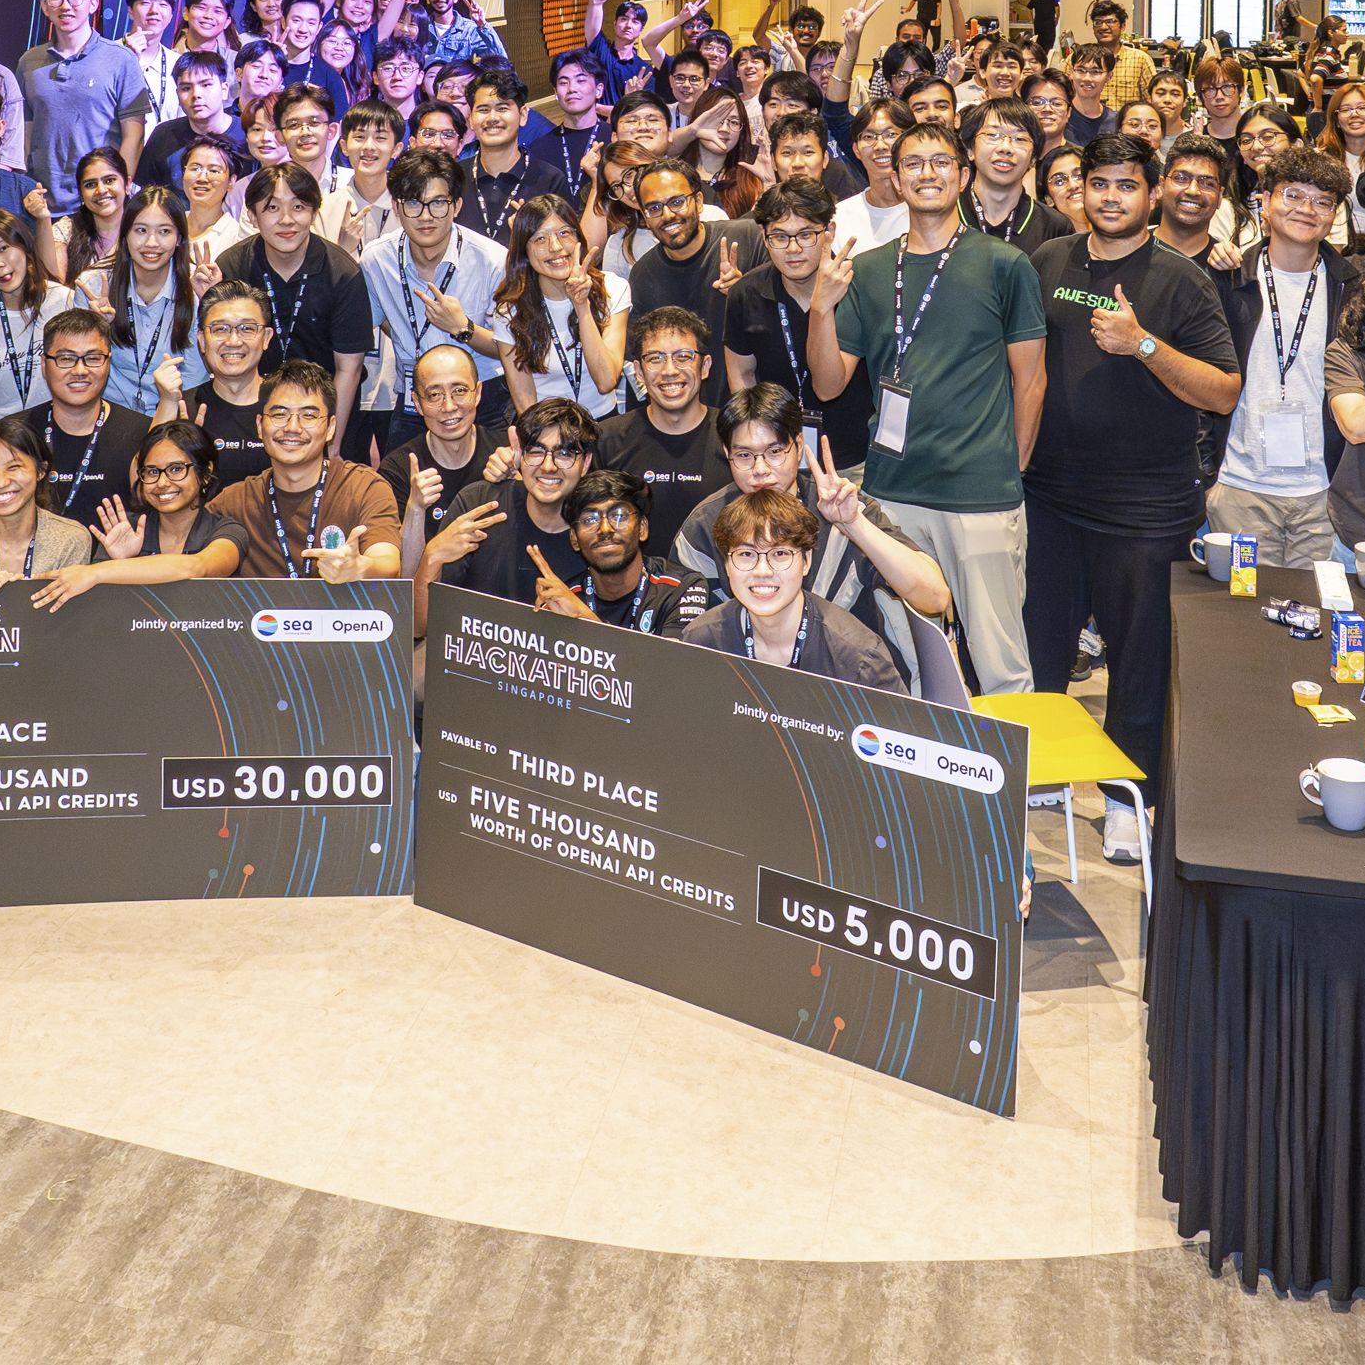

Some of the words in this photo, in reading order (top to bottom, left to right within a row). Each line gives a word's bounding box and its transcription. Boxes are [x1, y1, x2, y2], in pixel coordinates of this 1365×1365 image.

[1053, 287, 1132, 311] AWESOM
[225, 440, 239, 448] sea
[678, 474, 702, 482] OpenAI
[131, 618, 167, 632] Jointly
[170, 619, 224, 632] organized
[227, 619, 244, 631] by:
[283, 620, 313, 631] sea
[332, 620, 383, 633] OpenAI
[461, 615, 549, 655] REGIONAL
[554, 640, 617, 672] CODEX
[1348, 639, 1362, 647] TEA
[444, 634, 632, 709] HACKATHON
[497, 680, 572, 710] SINGAPORE
[733, 702, 768, 722] Jointly
[770, 711, 825, 737] organized
[827, 724, 844, 741] by:
[441, 730, 481, 751] PAYABLE
[484, 743, 497, 755] TO
[508, 749, 575, 786] THIRD
[584, 771, 658, 812] PLACE
[885, 741, 916, 761] sea
[937, 756, 993, 782] OpenAI
[172, 778, 225, 798] USD
[234, 764, 384, 801] 30,000
[18, 795, 51, 810] API
[58, 793, 138, 809] CREDITS
[438, 789, 458, 804] USD
[470, 785, 520, 819] FIVE
[528, 803, 656, 861] THOUSAND
[470, 812, 526, 844] WORTH
[531, 834, 552, 851] OF
[557, 841, 620, 874] OPENAI
[626, 864, 655, 886] API
[660, 875, 735, 911] CREDITS
[782, 897, 835, 933] USD
[844, 904, 974, 981] 5,000
